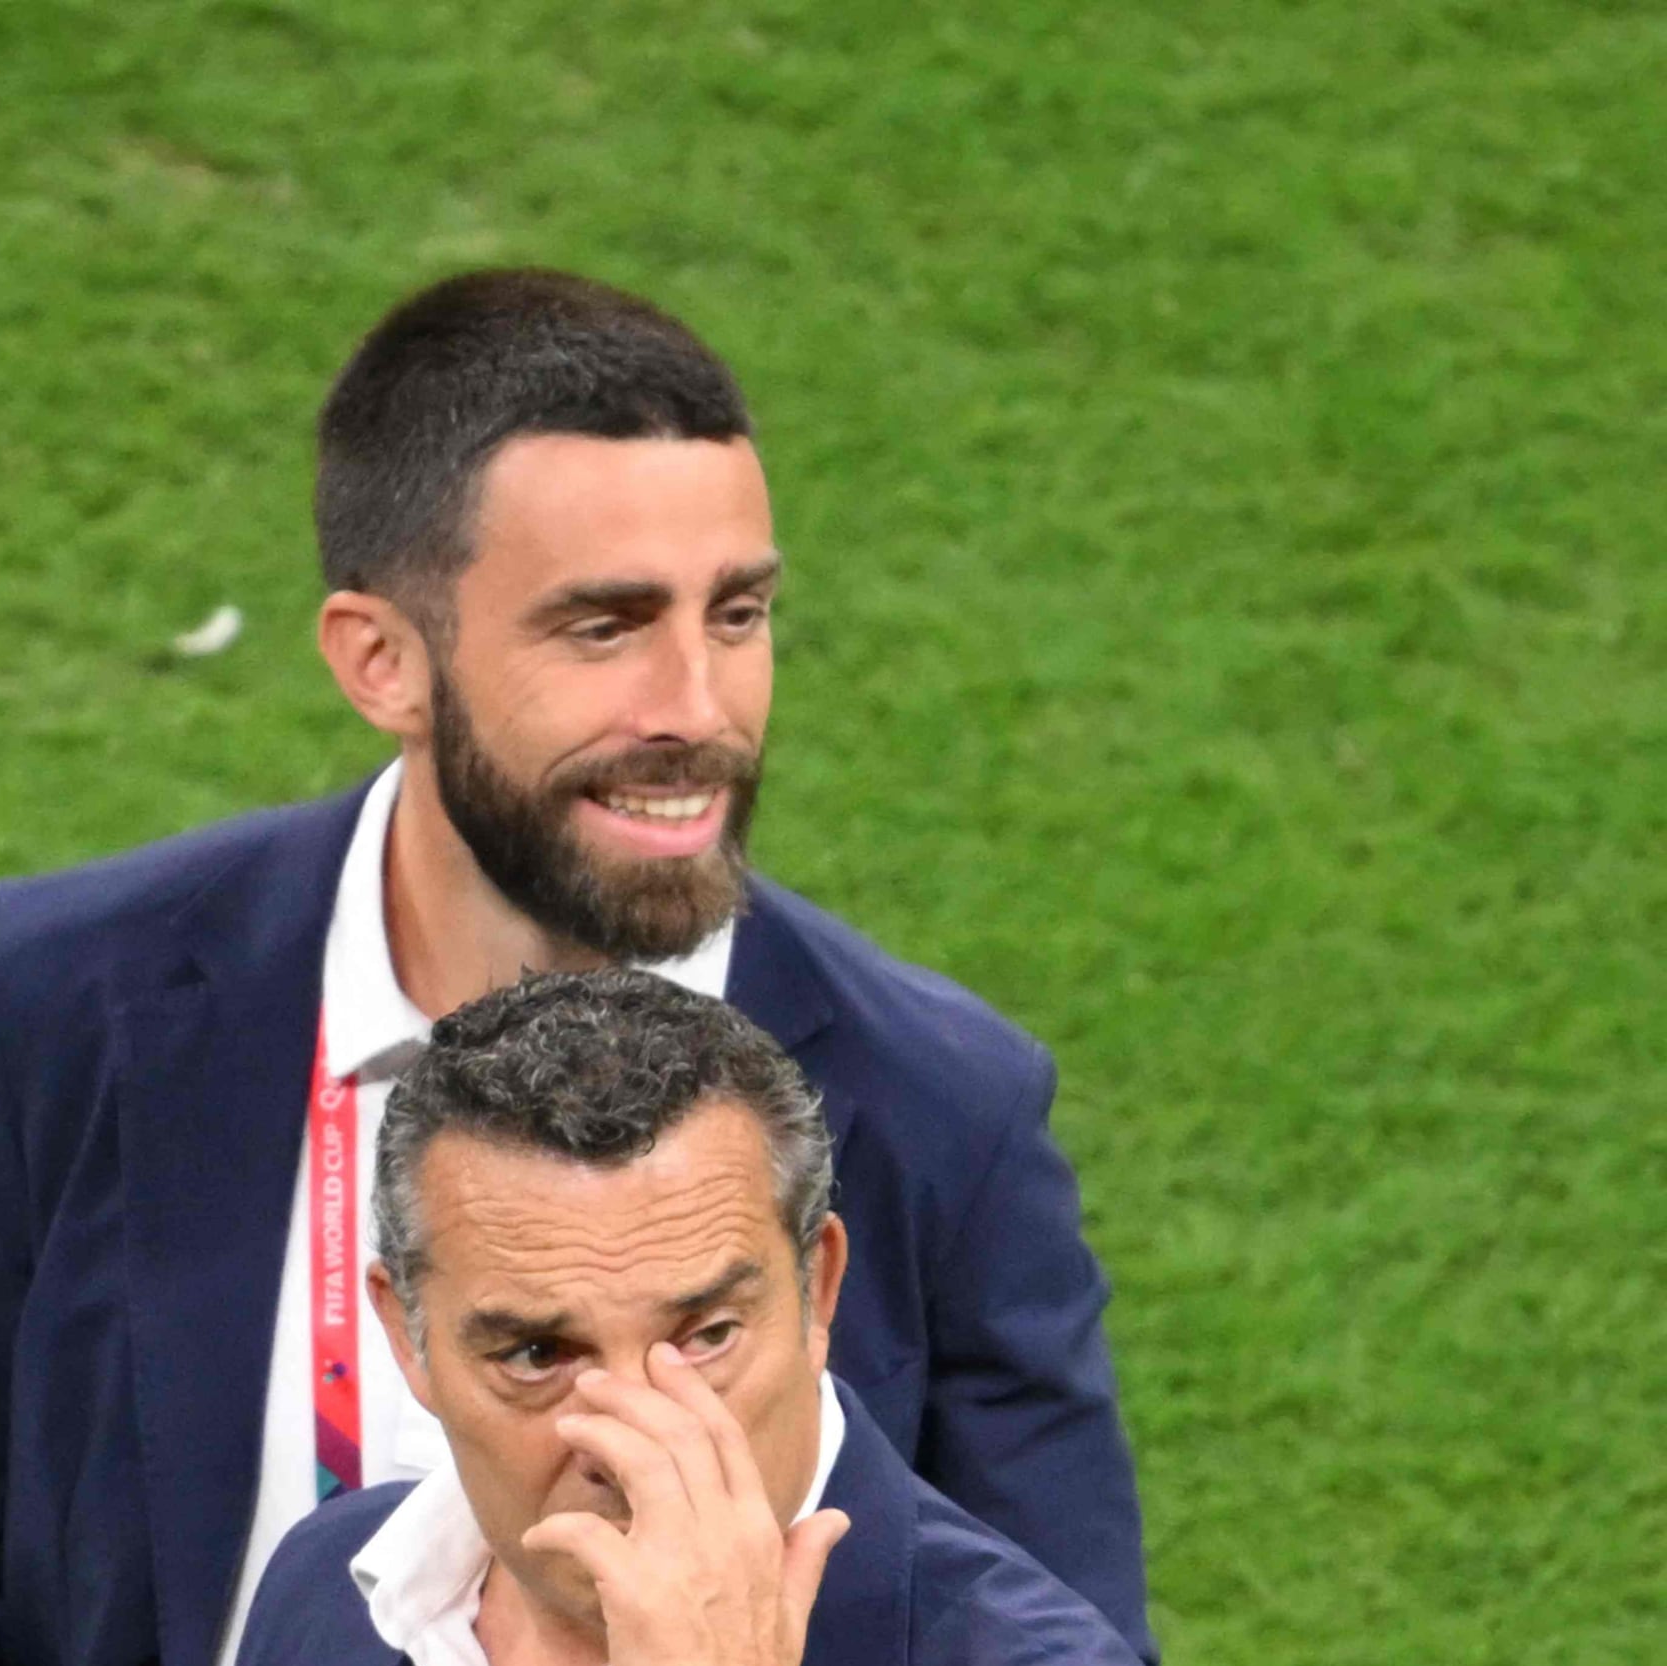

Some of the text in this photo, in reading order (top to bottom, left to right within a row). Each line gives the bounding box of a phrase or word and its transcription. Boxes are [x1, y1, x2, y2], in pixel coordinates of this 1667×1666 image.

[322, 1122, 344, 1172] CUP
[323, 1174, 345, 1267] WORLD
[324, 1270, 346, 1327] FIFA
